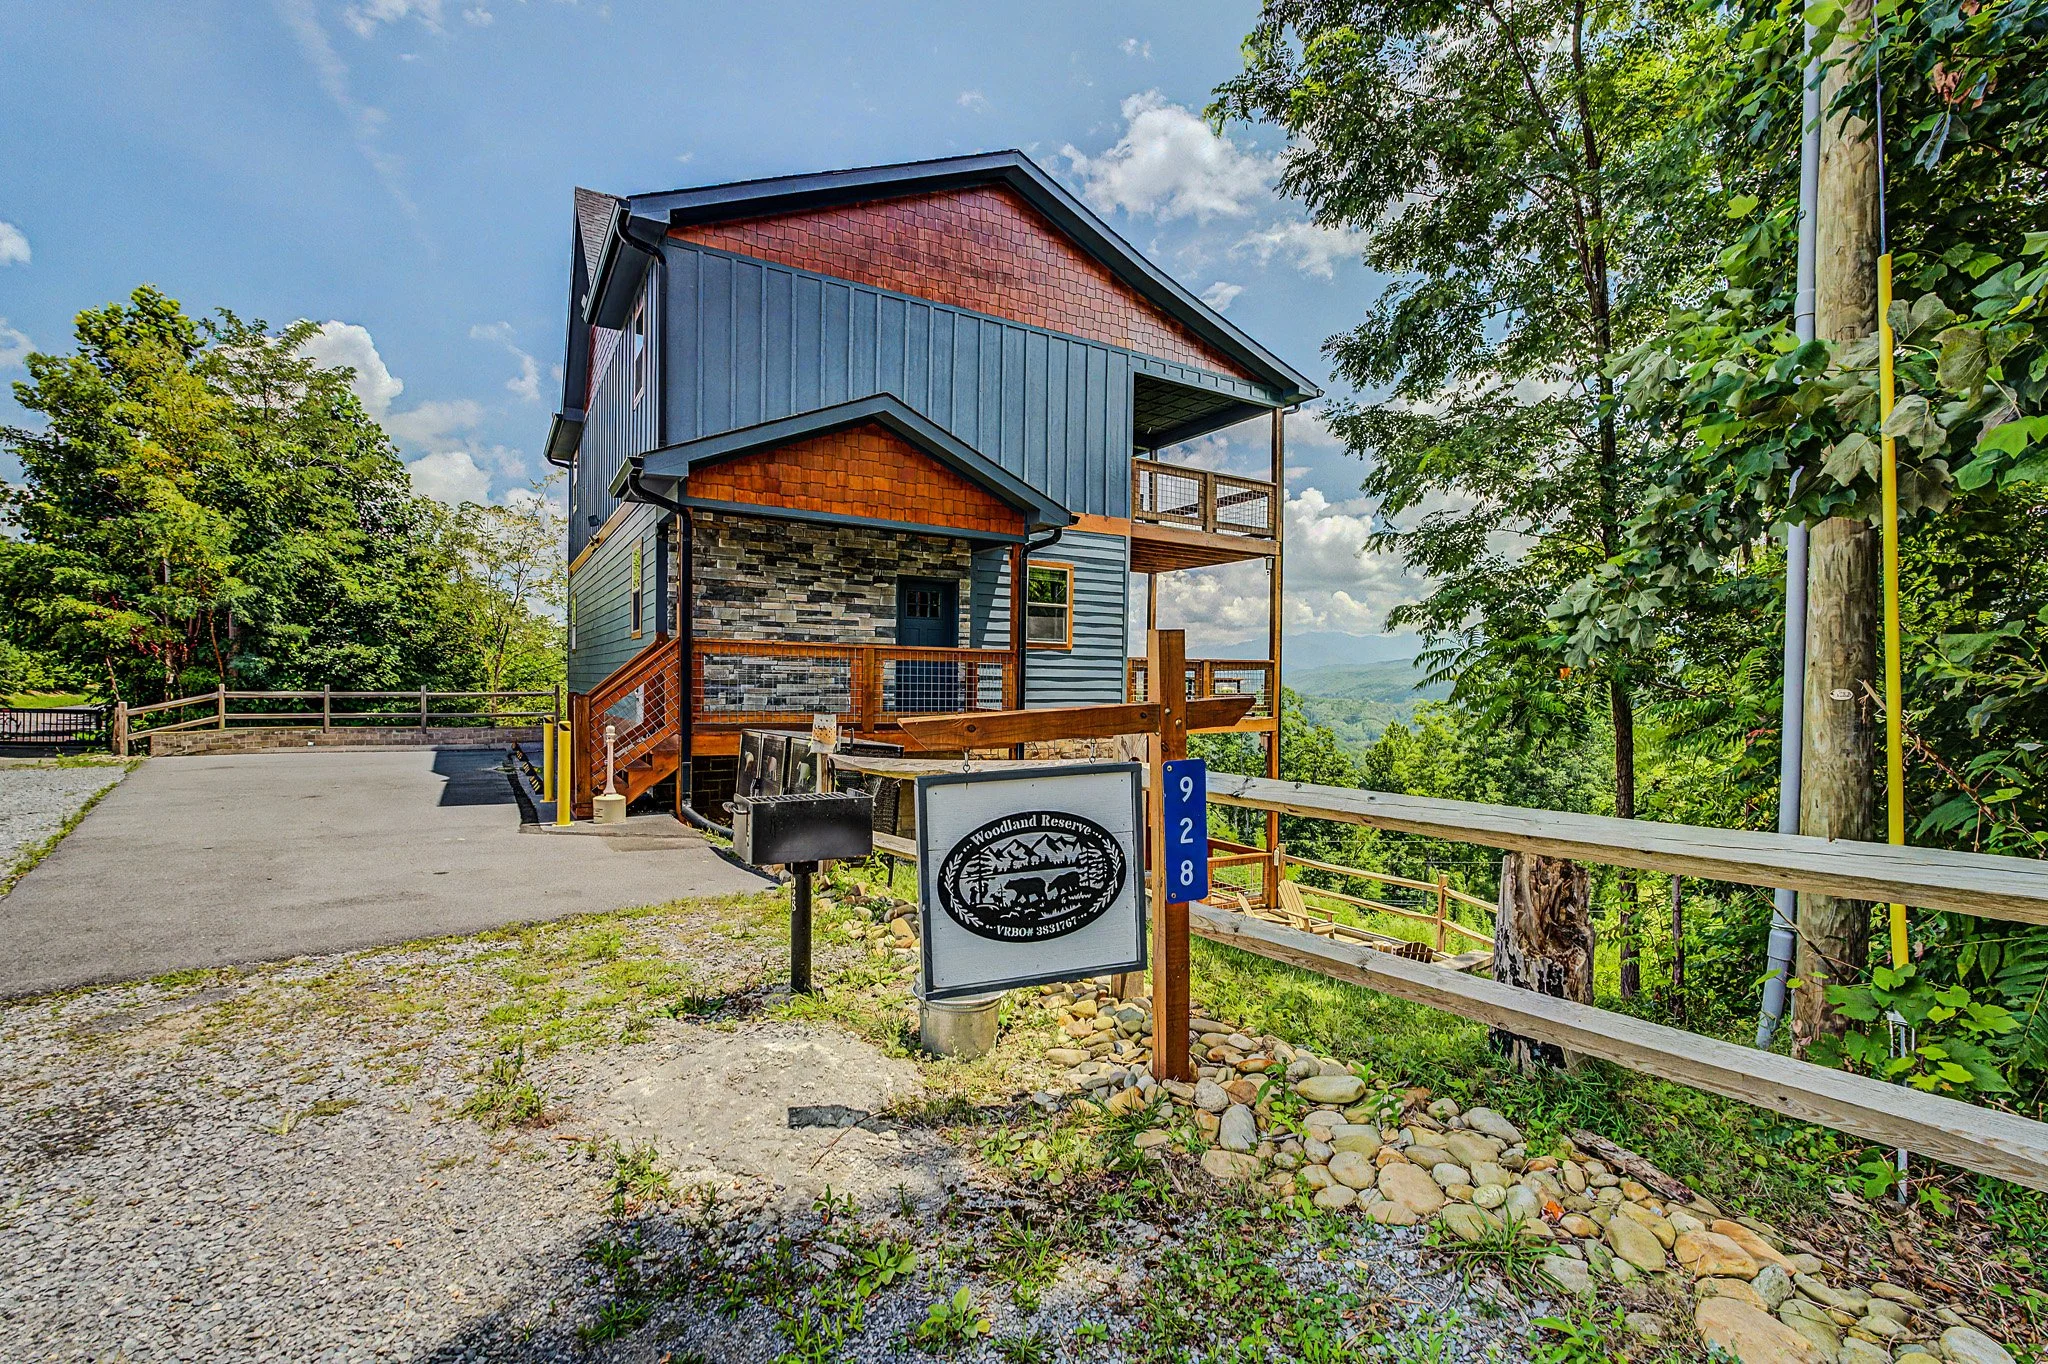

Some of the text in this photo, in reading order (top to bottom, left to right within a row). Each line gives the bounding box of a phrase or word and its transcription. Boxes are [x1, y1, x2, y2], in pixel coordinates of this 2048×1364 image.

[970, 815, 1092, 846] Woodland Reserve
[1179, 776, 1194, 886] 928
[997, 916, 1077, 937] VRBO# 3831767
